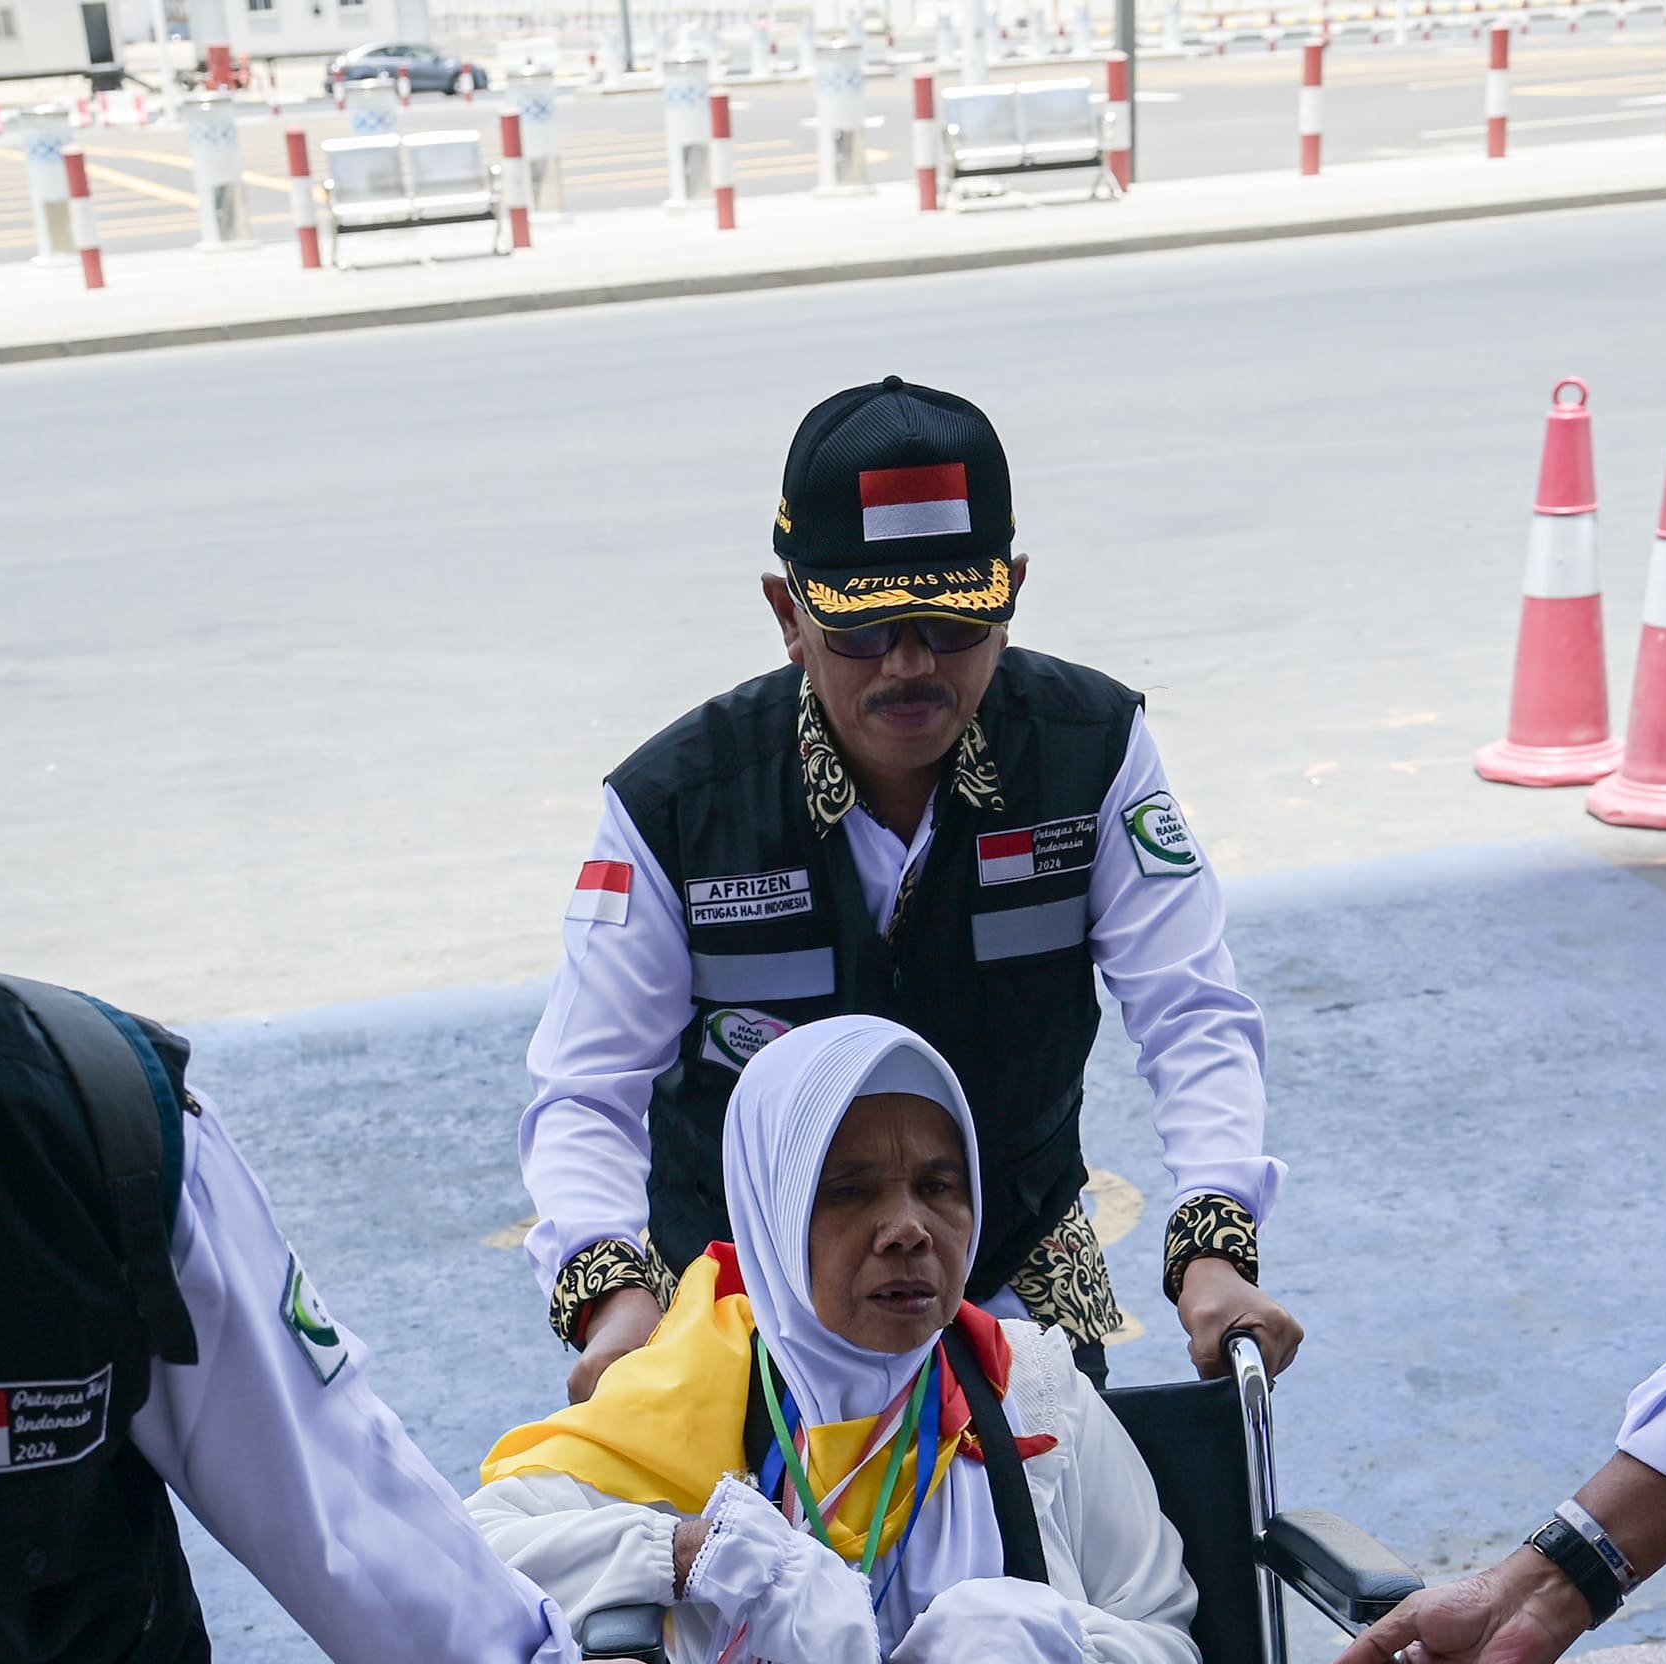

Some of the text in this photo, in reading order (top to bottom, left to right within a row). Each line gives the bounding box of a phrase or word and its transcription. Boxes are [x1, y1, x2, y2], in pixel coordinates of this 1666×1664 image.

[844, 567, 983, 591] PETUGAS HAJI
[1033, 826, 1073, 842] Petugas
[1035, 837, 1083, 855] Indonesia
[1037, 858, 1061, 871] 2024
[709, 875, 791, 900] AFRIZEN
[694, 896, 808, 921] PETUGAS HAJI INDONESIA
[729, 1032, 769, 1045] RAMAH
[737, 1025, 762, 1037] HAJI
[730, 1040, 760, 1052] LANSI
[11, 1390, 84, 1411] Petugas
[15, 1441, 57, 1461] 2024
